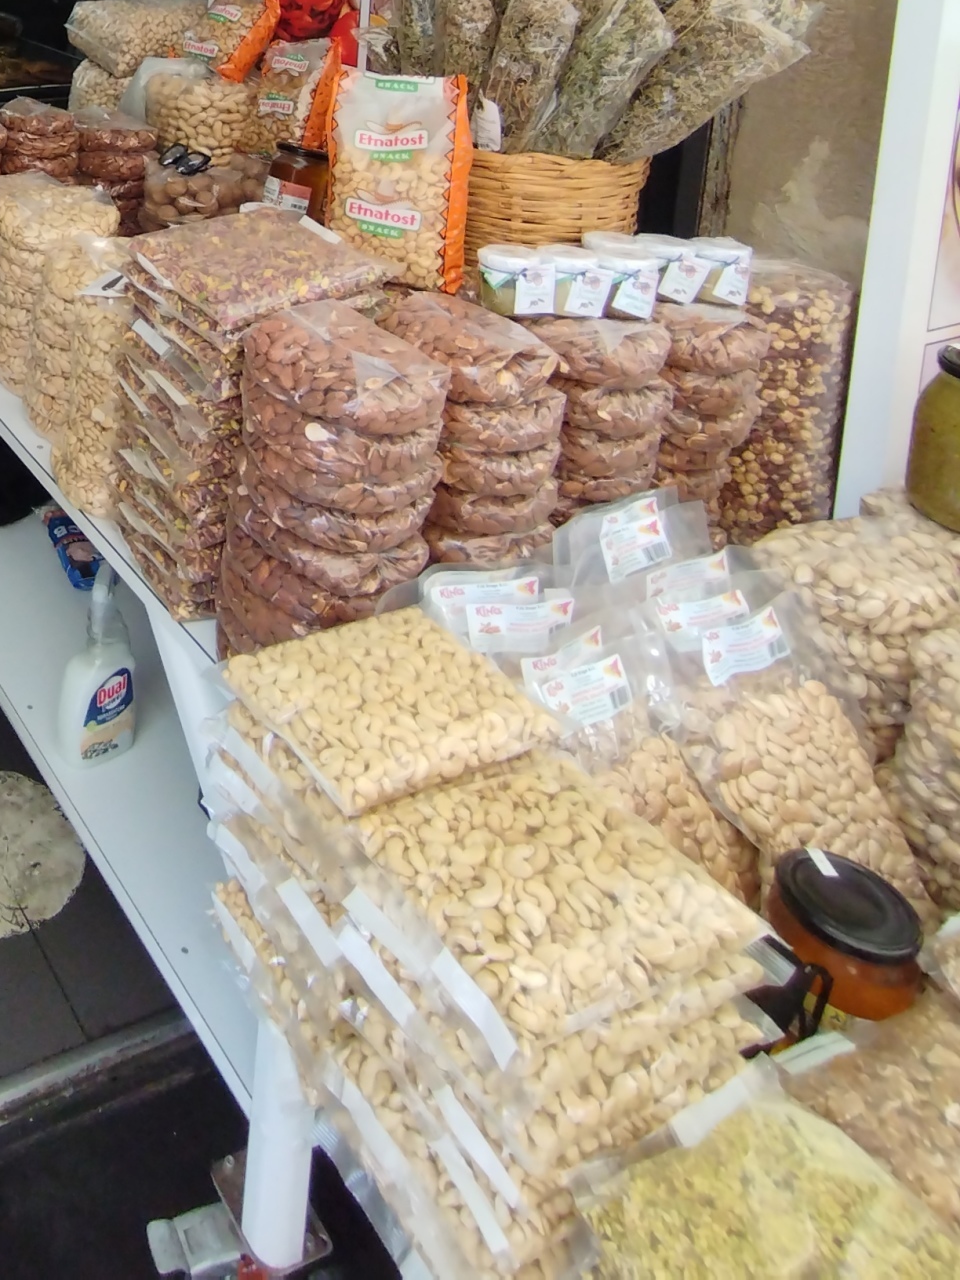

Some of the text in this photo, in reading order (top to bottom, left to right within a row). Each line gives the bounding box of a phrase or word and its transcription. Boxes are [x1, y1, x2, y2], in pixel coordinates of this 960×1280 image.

[358, 133, 425, 147] Etnatost
[348, 202, 417, 226] Etnatost
[97, 674, 128, 707] Dual
